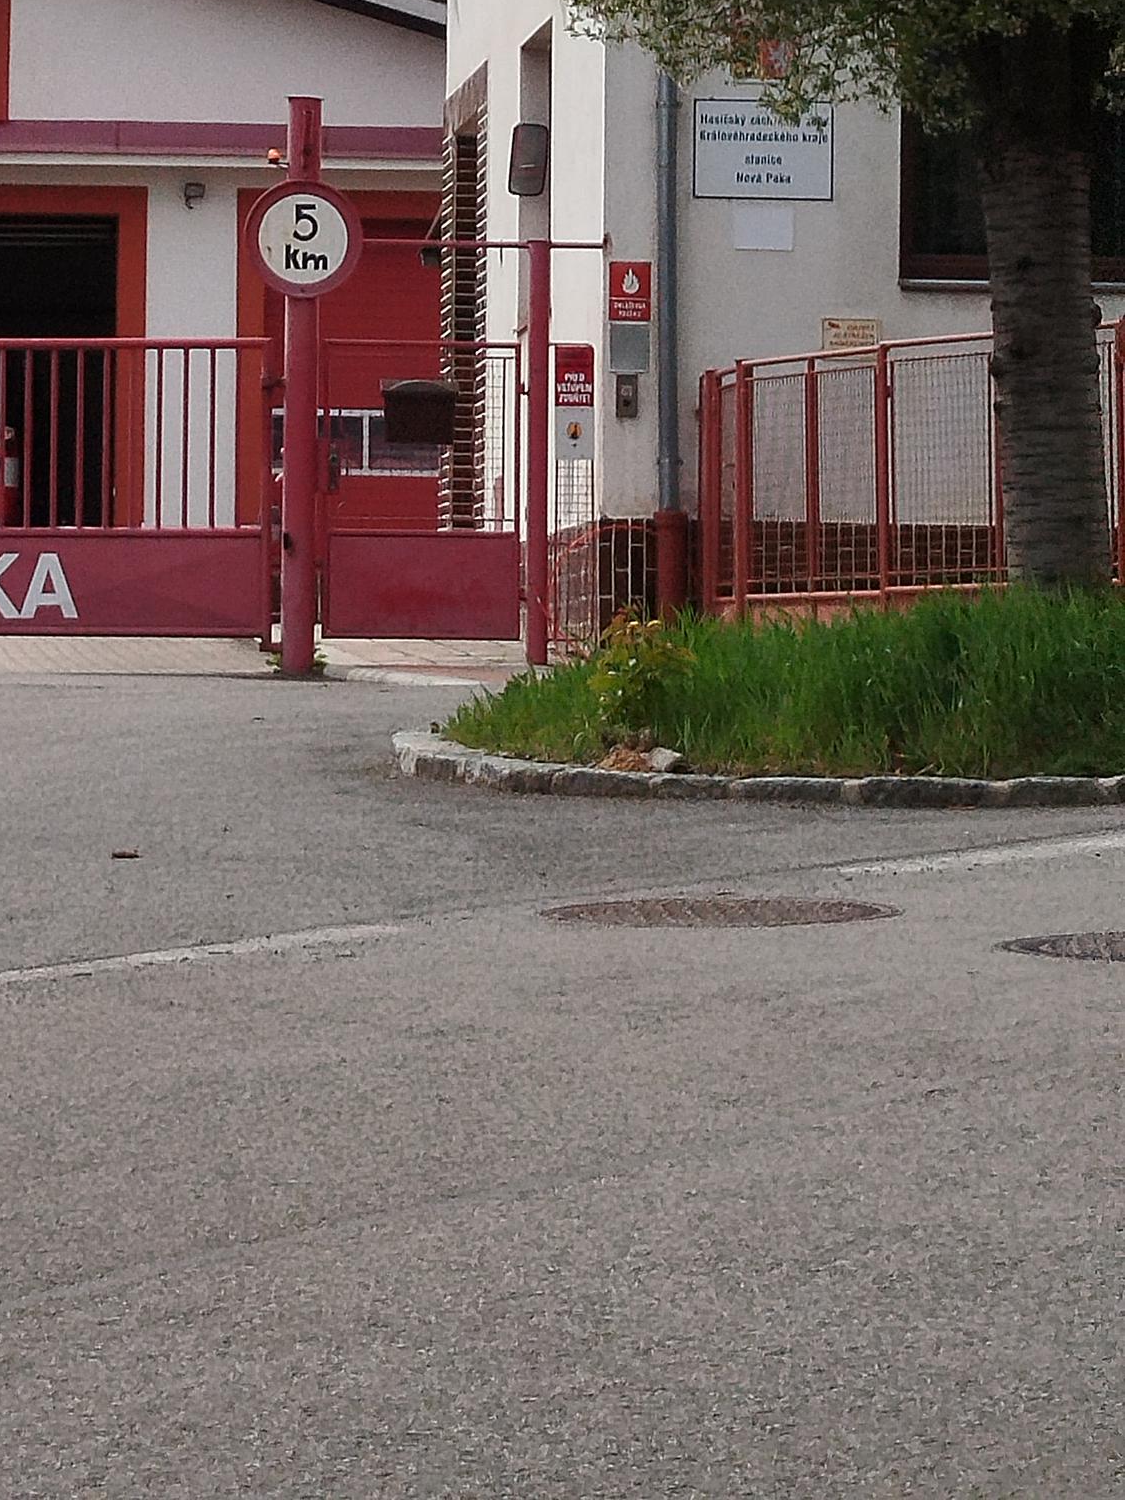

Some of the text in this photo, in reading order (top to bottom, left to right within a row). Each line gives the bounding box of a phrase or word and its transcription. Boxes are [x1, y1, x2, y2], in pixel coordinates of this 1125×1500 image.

[744, 154, 782, 165] stanice
[736, 172, 791, 184] Nová Paka
[293, 204, 318, 241] 5
[285, 243, 328, 270] km
